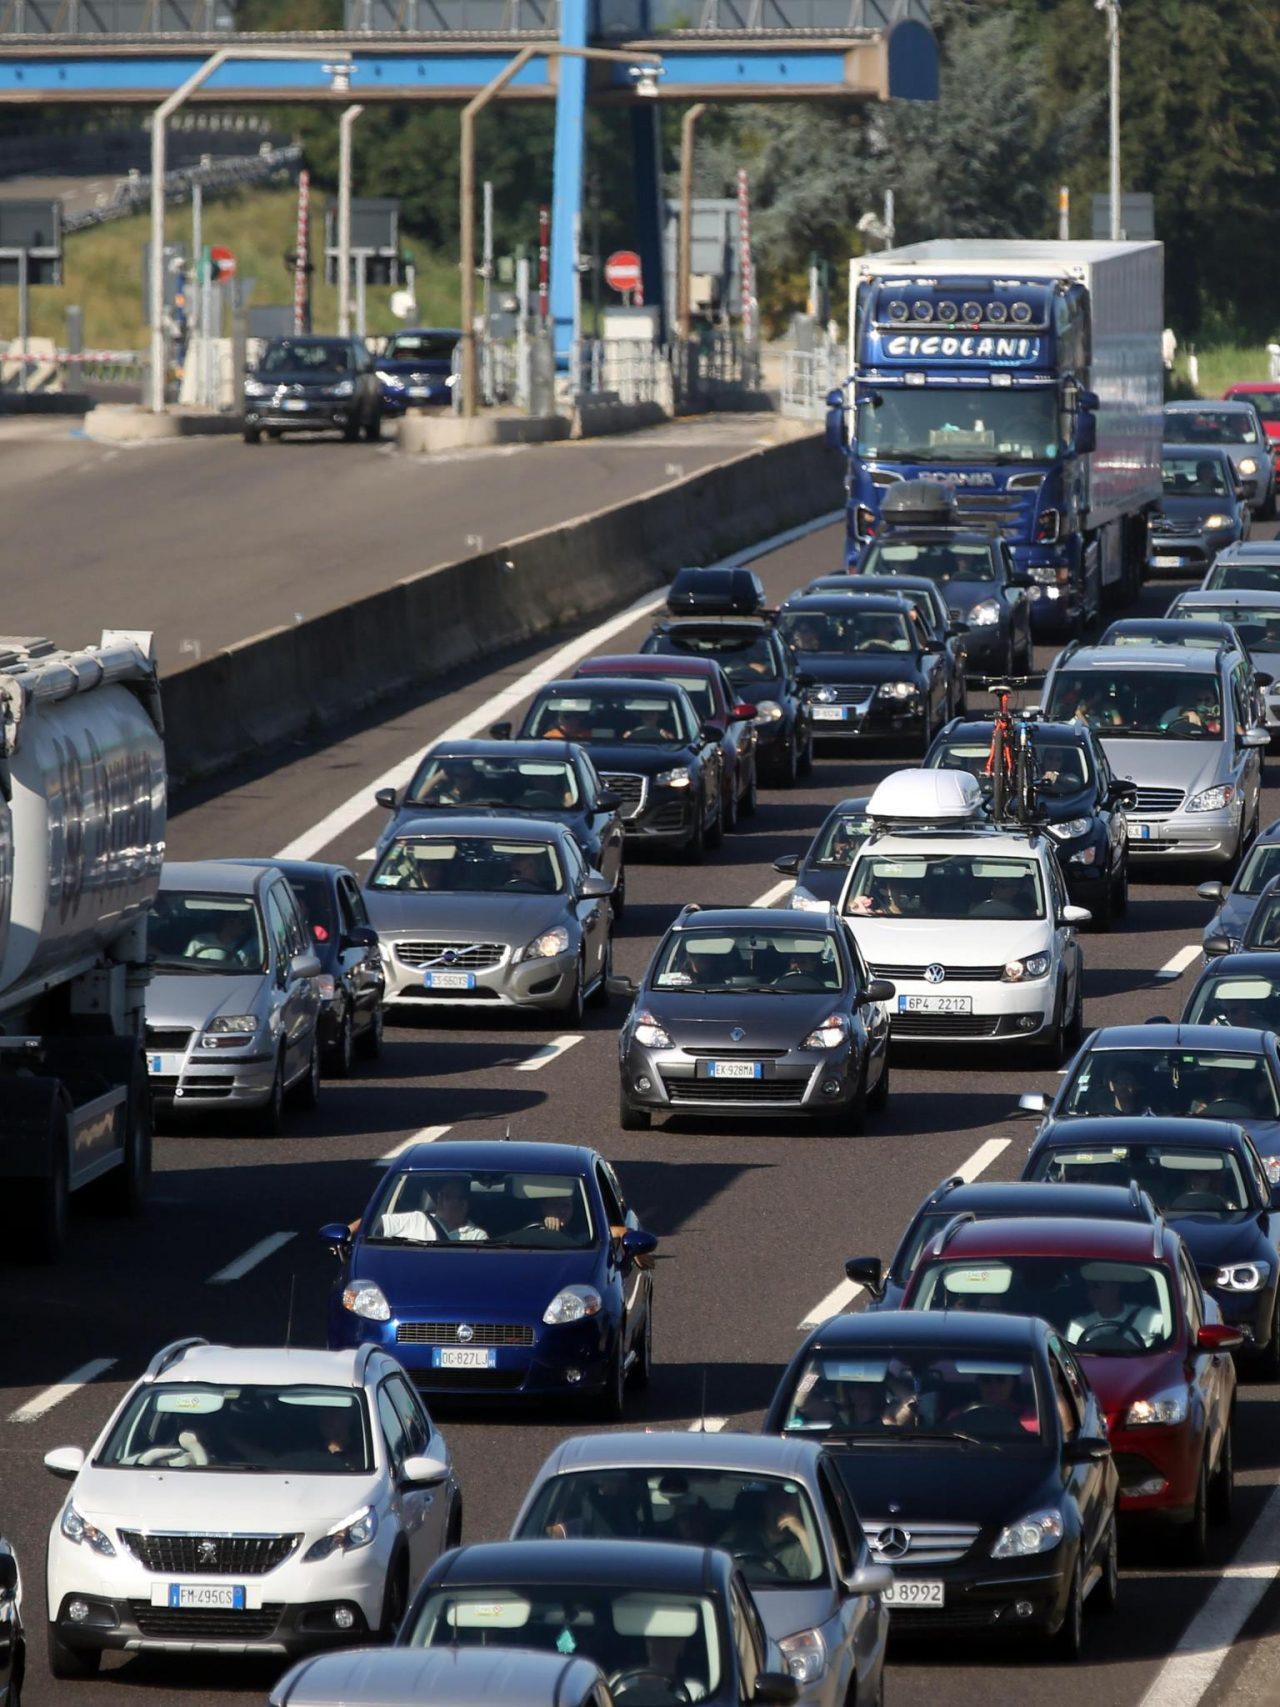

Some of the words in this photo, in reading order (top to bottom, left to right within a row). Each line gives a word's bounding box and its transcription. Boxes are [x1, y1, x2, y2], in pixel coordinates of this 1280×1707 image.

[888, 336, 1031, 358] CICOLANI
[908, 997, 929, 1009] 6P4
[938, 998, 966, 1010] 2212
[899, 1584, 941, 1601] 8992
